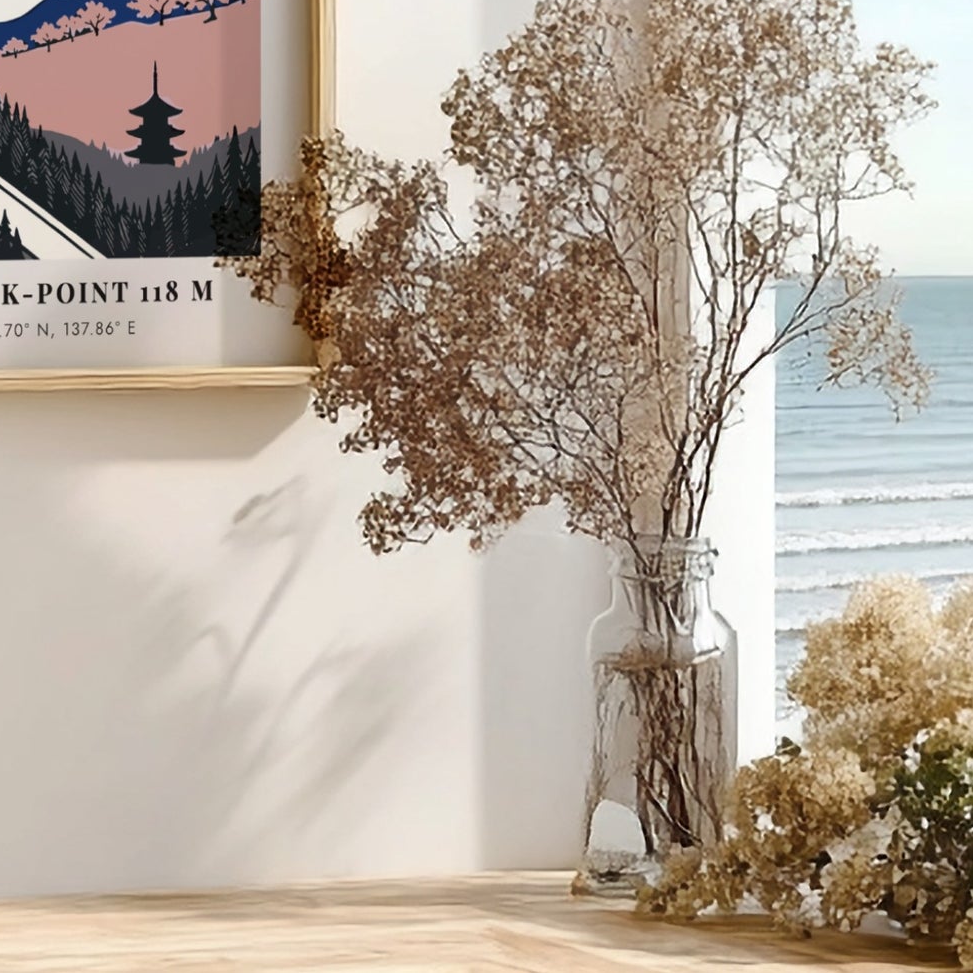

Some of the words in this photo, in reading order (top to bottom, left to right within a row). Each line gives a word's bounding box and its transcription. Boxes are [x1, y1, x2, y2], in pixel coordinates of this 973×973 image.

[1, 281, 129, 306] K-POINT
[140, 280, 179, 303] 118
[191, 279, 213, 302] M
[37, 322, 55, 339] N,
[63, 320, 121, 337] 137.86°
[127, 320, 136, 335] E
